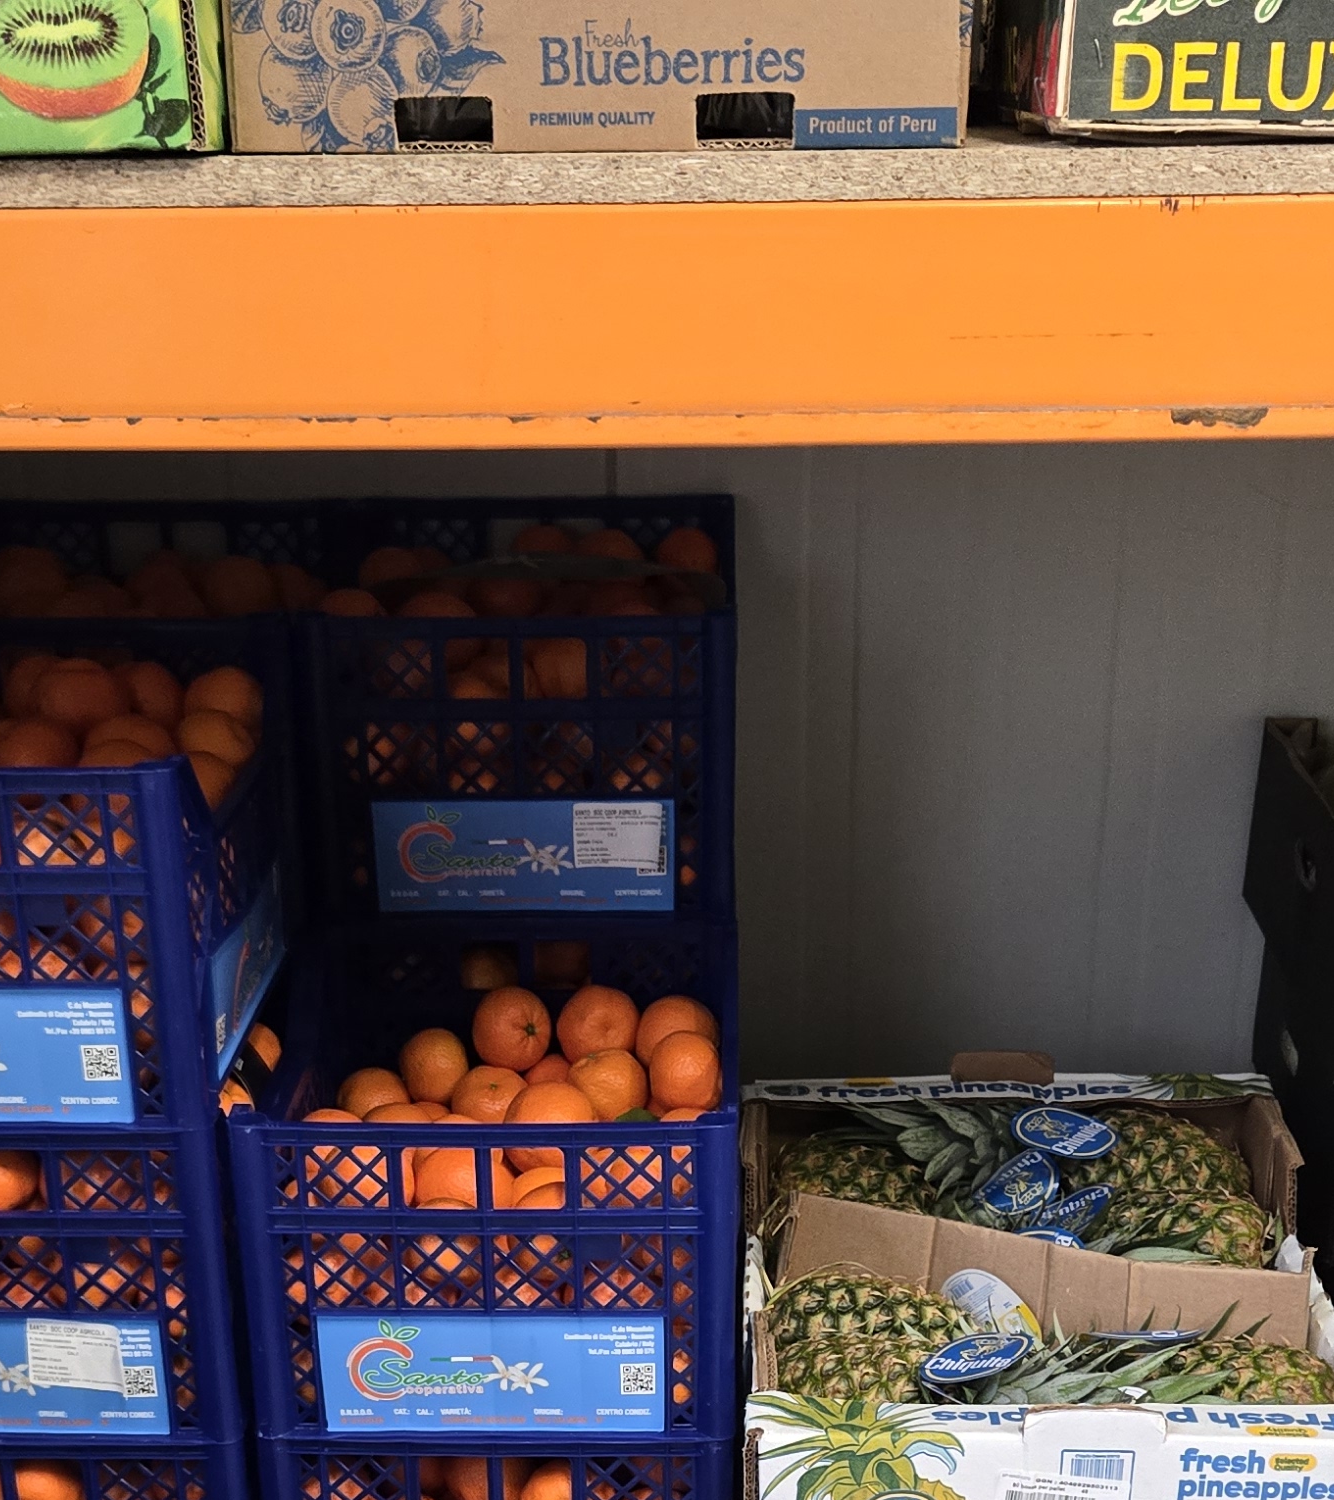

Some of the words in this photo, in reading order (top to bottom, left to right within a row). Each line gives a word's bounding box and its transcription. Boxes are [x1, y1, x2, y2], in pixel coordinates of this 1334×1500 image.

[583, 18, 638, 48] Fresh
[539, 36, 805, 87] Blueberries
[529, 112, 594, 127] PREMIUM
[597, 111, 656, 129] QUALITY
[808, 115, 872, 135] Product
[877, 115, 895, 132] of
[900, 114, 937, 132] Peru
[414, 842, 518, 870] Santo
[817, 1085, 921, 1099] fresh
[1052, 1121, 1107, 1155] Chiquita
[363, 1358, 488, 1388] Santo
[925, 1356, 1012, 1372] Chiquita
[1180, 1448, 1265, 1475] fresh
